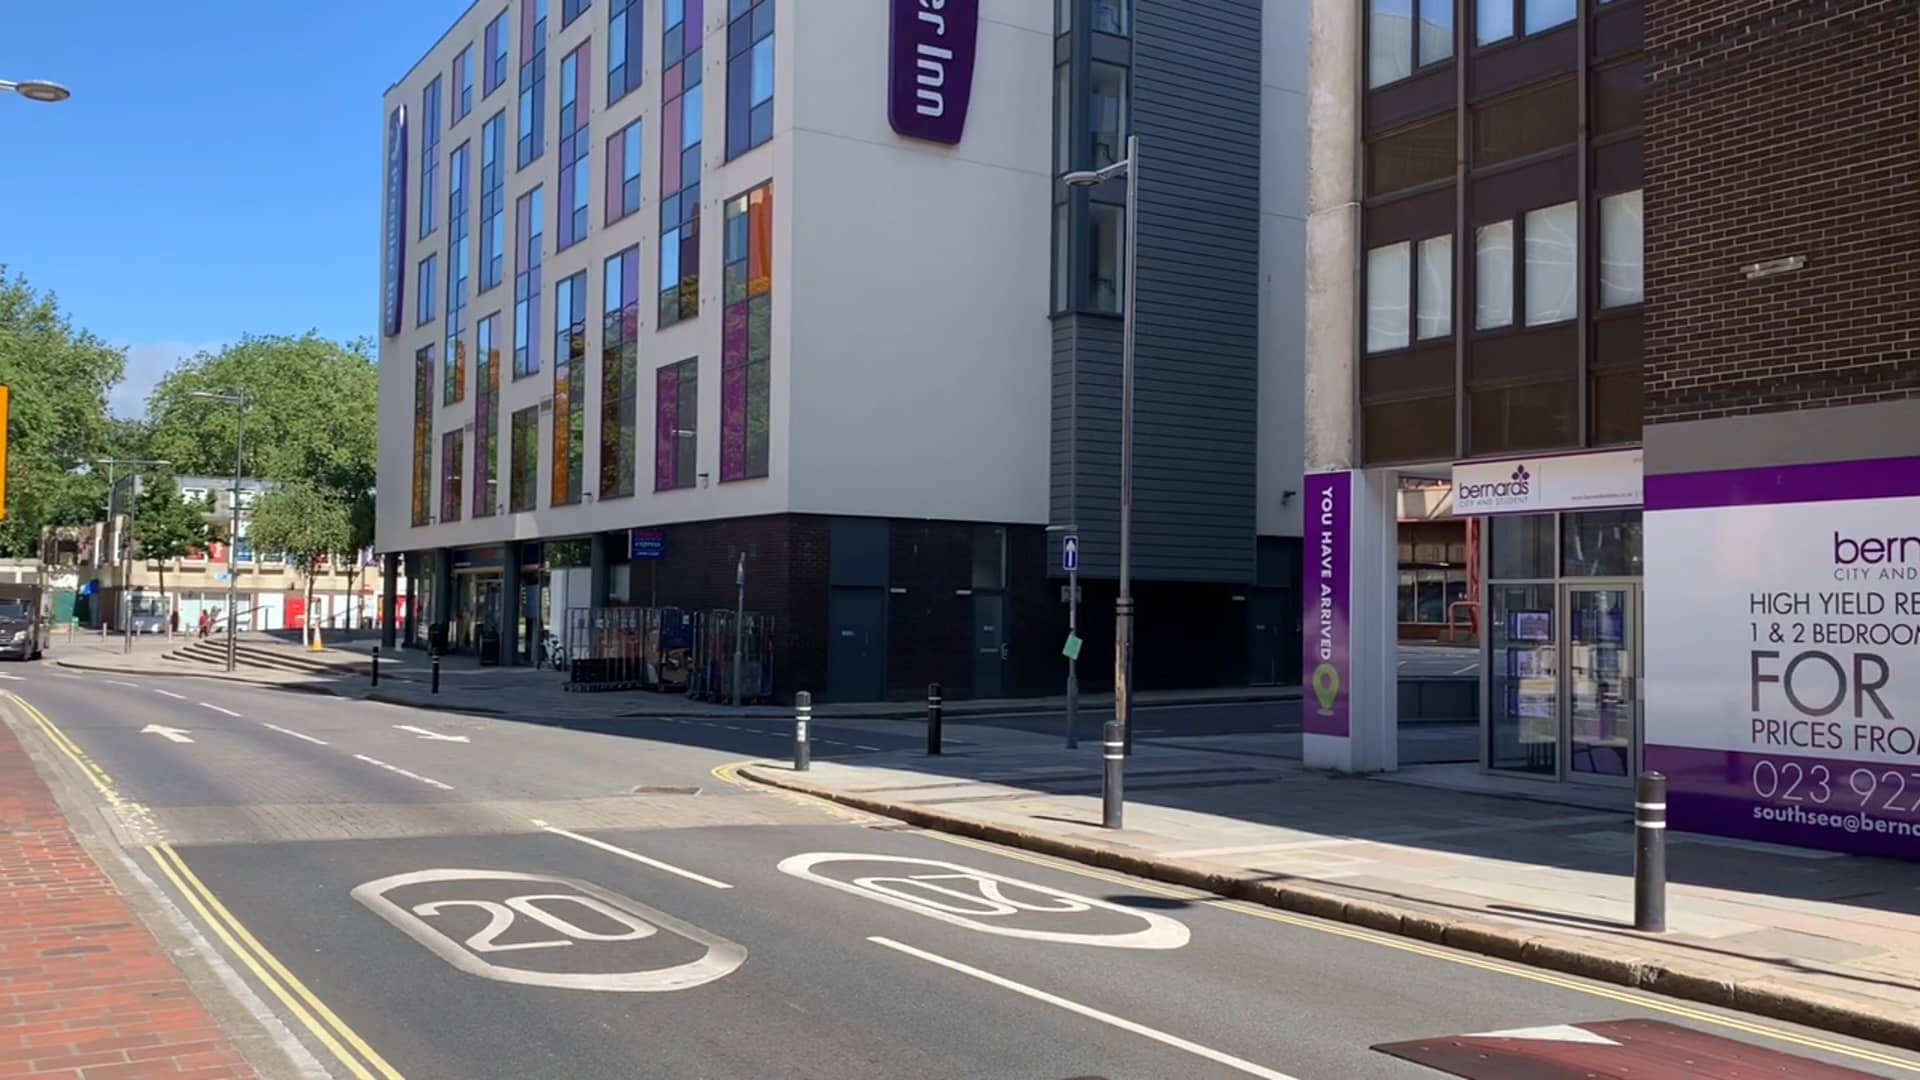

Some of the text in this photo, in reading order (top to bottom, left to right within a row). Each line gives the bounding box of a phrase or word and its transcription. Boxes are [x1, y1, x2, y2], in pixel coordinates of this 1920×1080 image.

[916, 43, 953, 117] Inn
[1459, 479, 1530, 500] bernards
[1320, 486, 1333, 660] YOU HAVE ARRIVED
[1833, 567, 1918, 581] CITY AND
[1750, 592, 1920, 615] HIGH YIELD RE
[1750, 622, 1920, 645] 1 & 2 BEDROO
[1751, 650, 1895, 720] FOR
[1751, 718, 1920, 756] PRICES FRO
[1752, 760, 1831, 803] 023
[852, 873, 1093, 916] 20
[411, 894, 659, 953] 20
